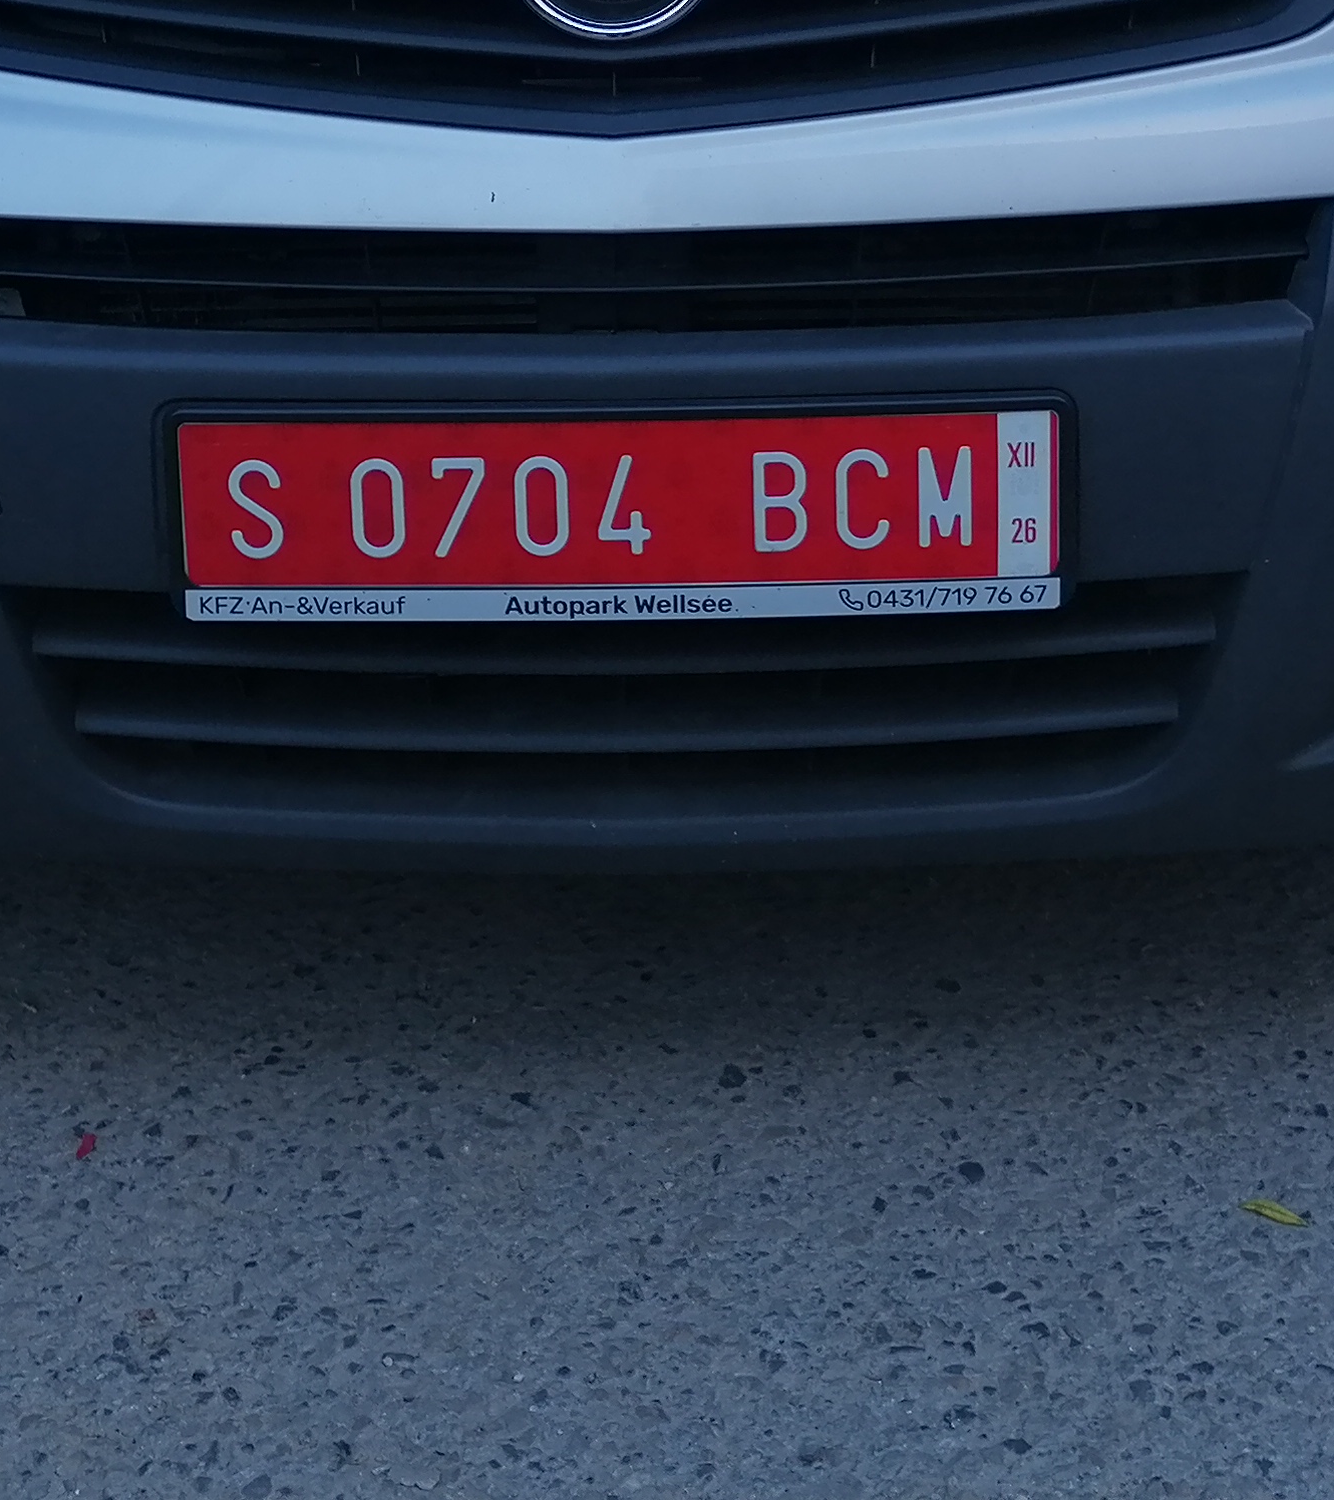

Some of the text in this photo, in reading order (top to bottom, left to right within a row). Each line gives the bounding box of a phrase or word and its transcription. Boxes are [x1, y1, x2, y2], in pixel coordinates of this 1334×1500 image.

[1006, 441, 1036, 468] XII
[227, 445, 974, 559] S 0704 BCM
[1011, 517, 1038, 544] 26
[504, 595, 628, 619] Autopark
[866, 584, 1048, 609] 0431/719 76 67
